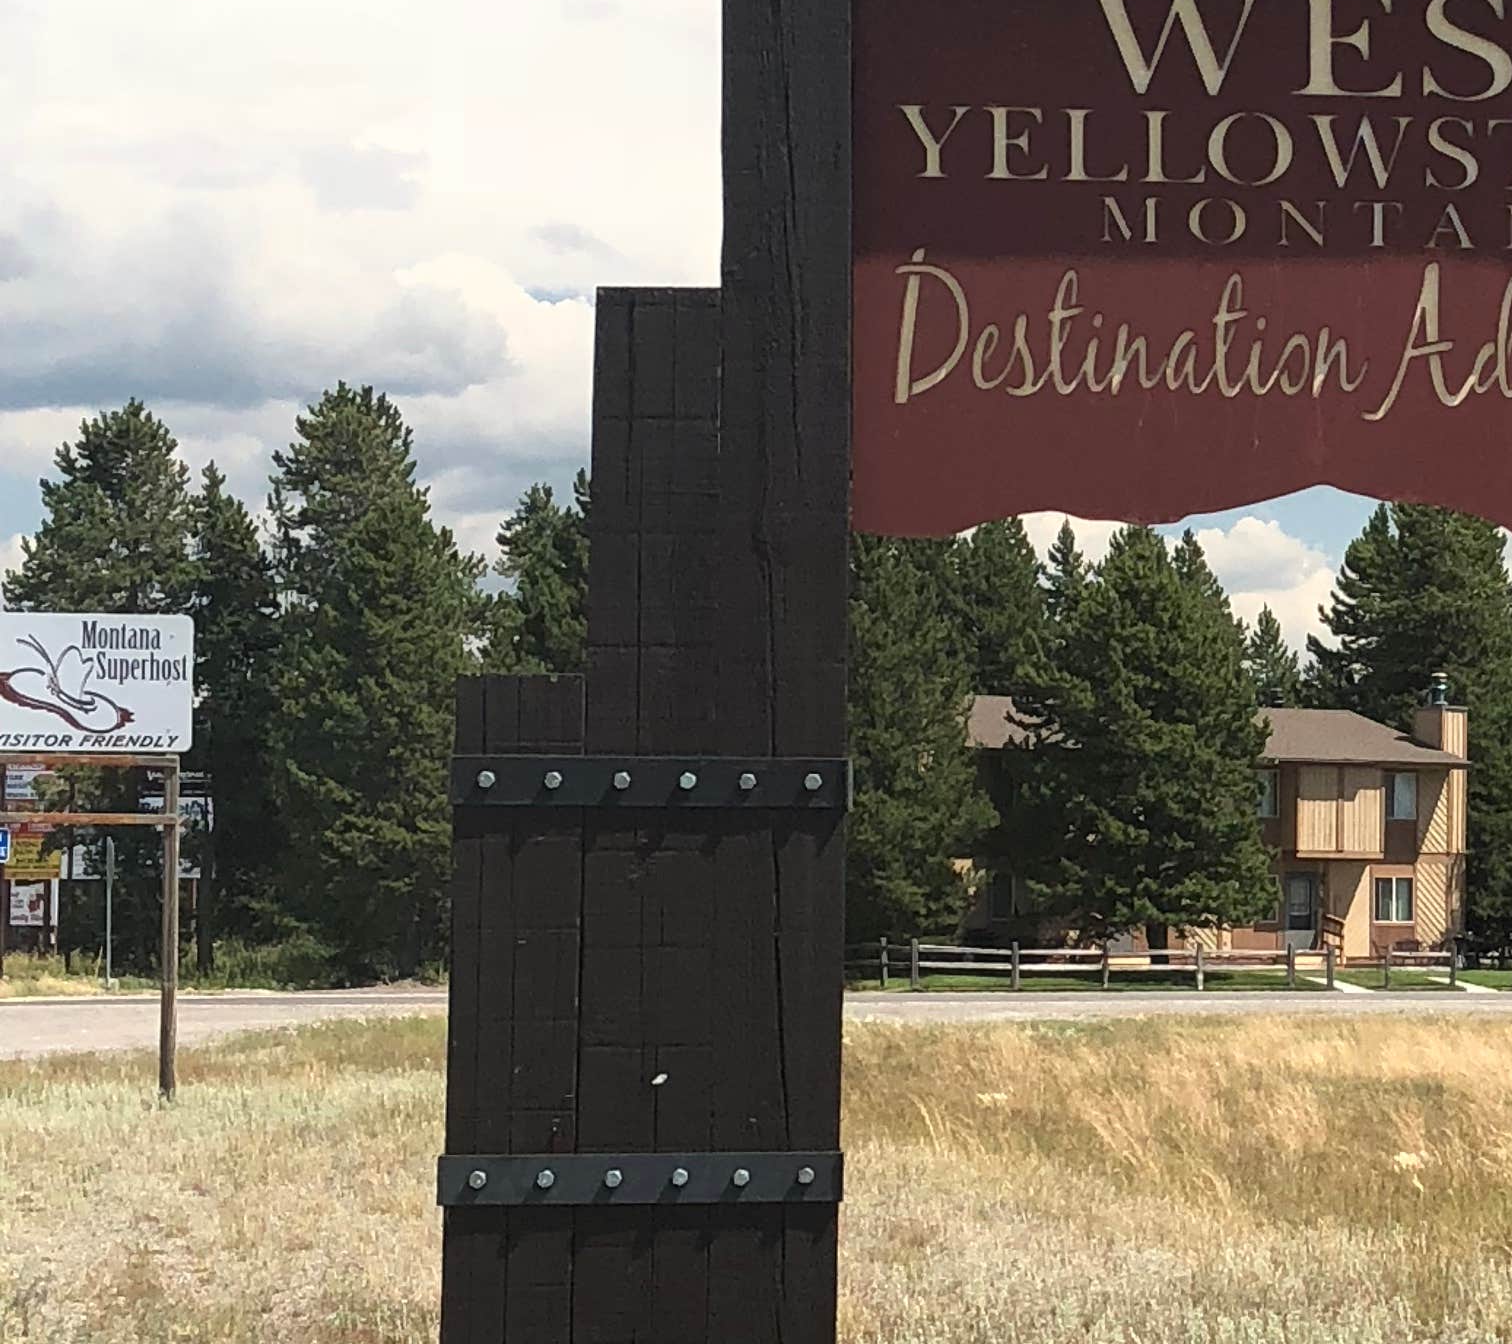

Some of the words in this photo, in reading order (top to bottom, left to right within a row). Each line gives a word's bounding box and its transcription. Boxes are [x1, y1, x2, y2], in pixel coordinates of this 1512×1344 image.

[893, 247, 1370, 404] Destination
[81, 620, 162, 650] Montana
[96, 651, 188, 685] Superhost
[78, 734, 179, 748] FRIENDLY
